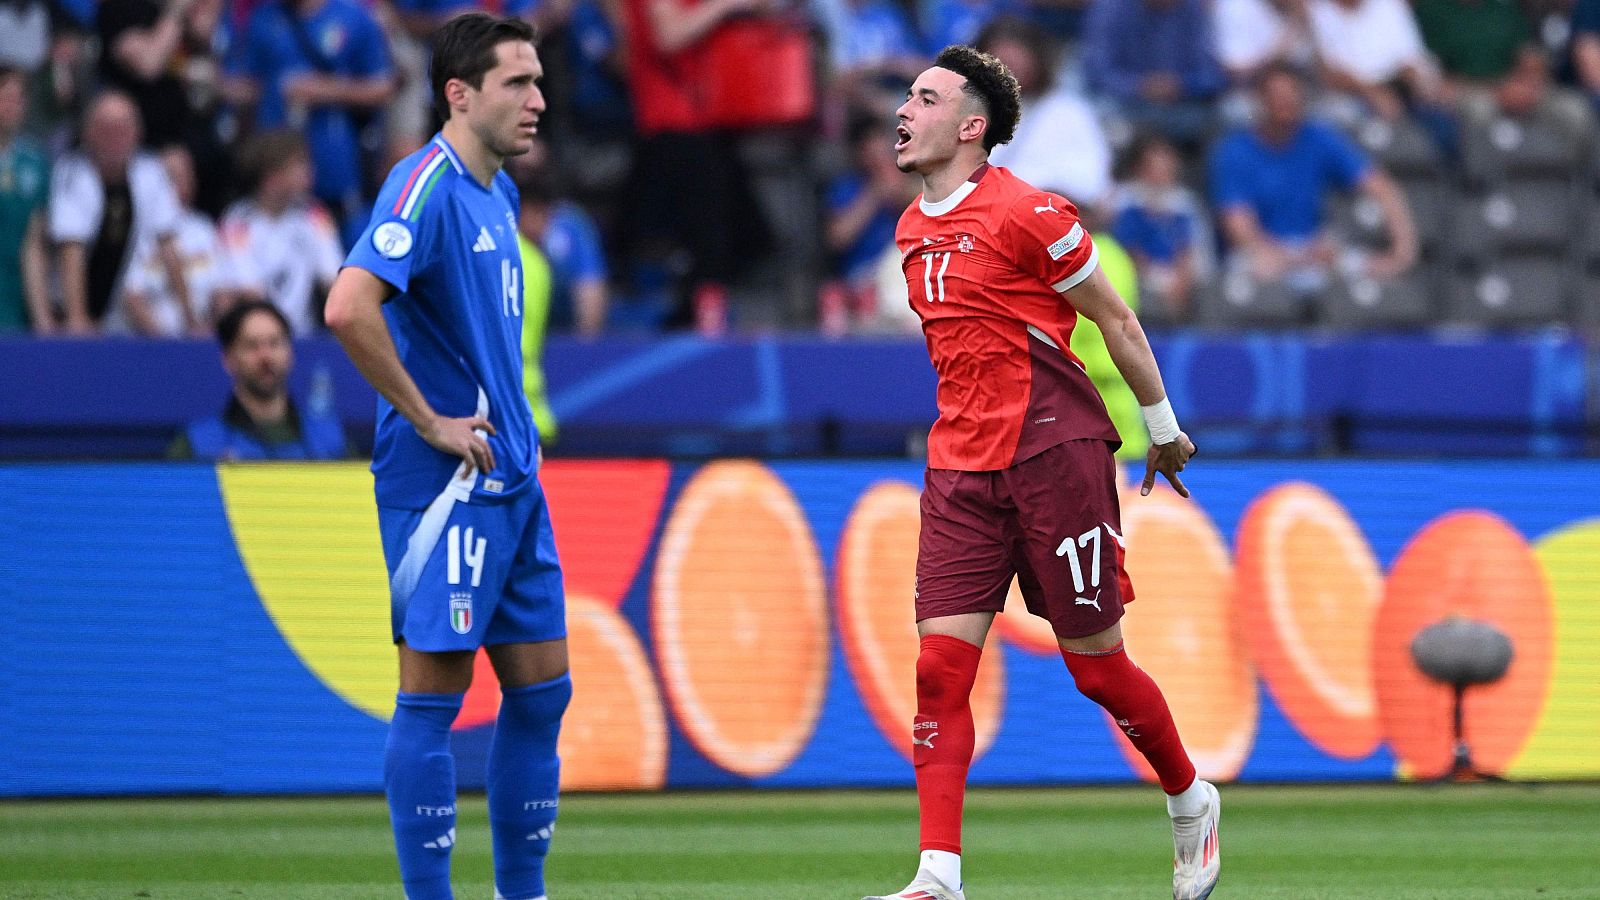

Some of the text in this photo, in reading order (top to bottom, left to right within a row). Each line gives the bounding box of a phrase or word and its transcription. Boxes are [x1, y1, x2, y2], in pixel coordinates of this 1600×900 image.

[921, 250, 951, 302] 17
[447, 525, 487, 587] 14
[1056, 526, 1101, 593] 17
